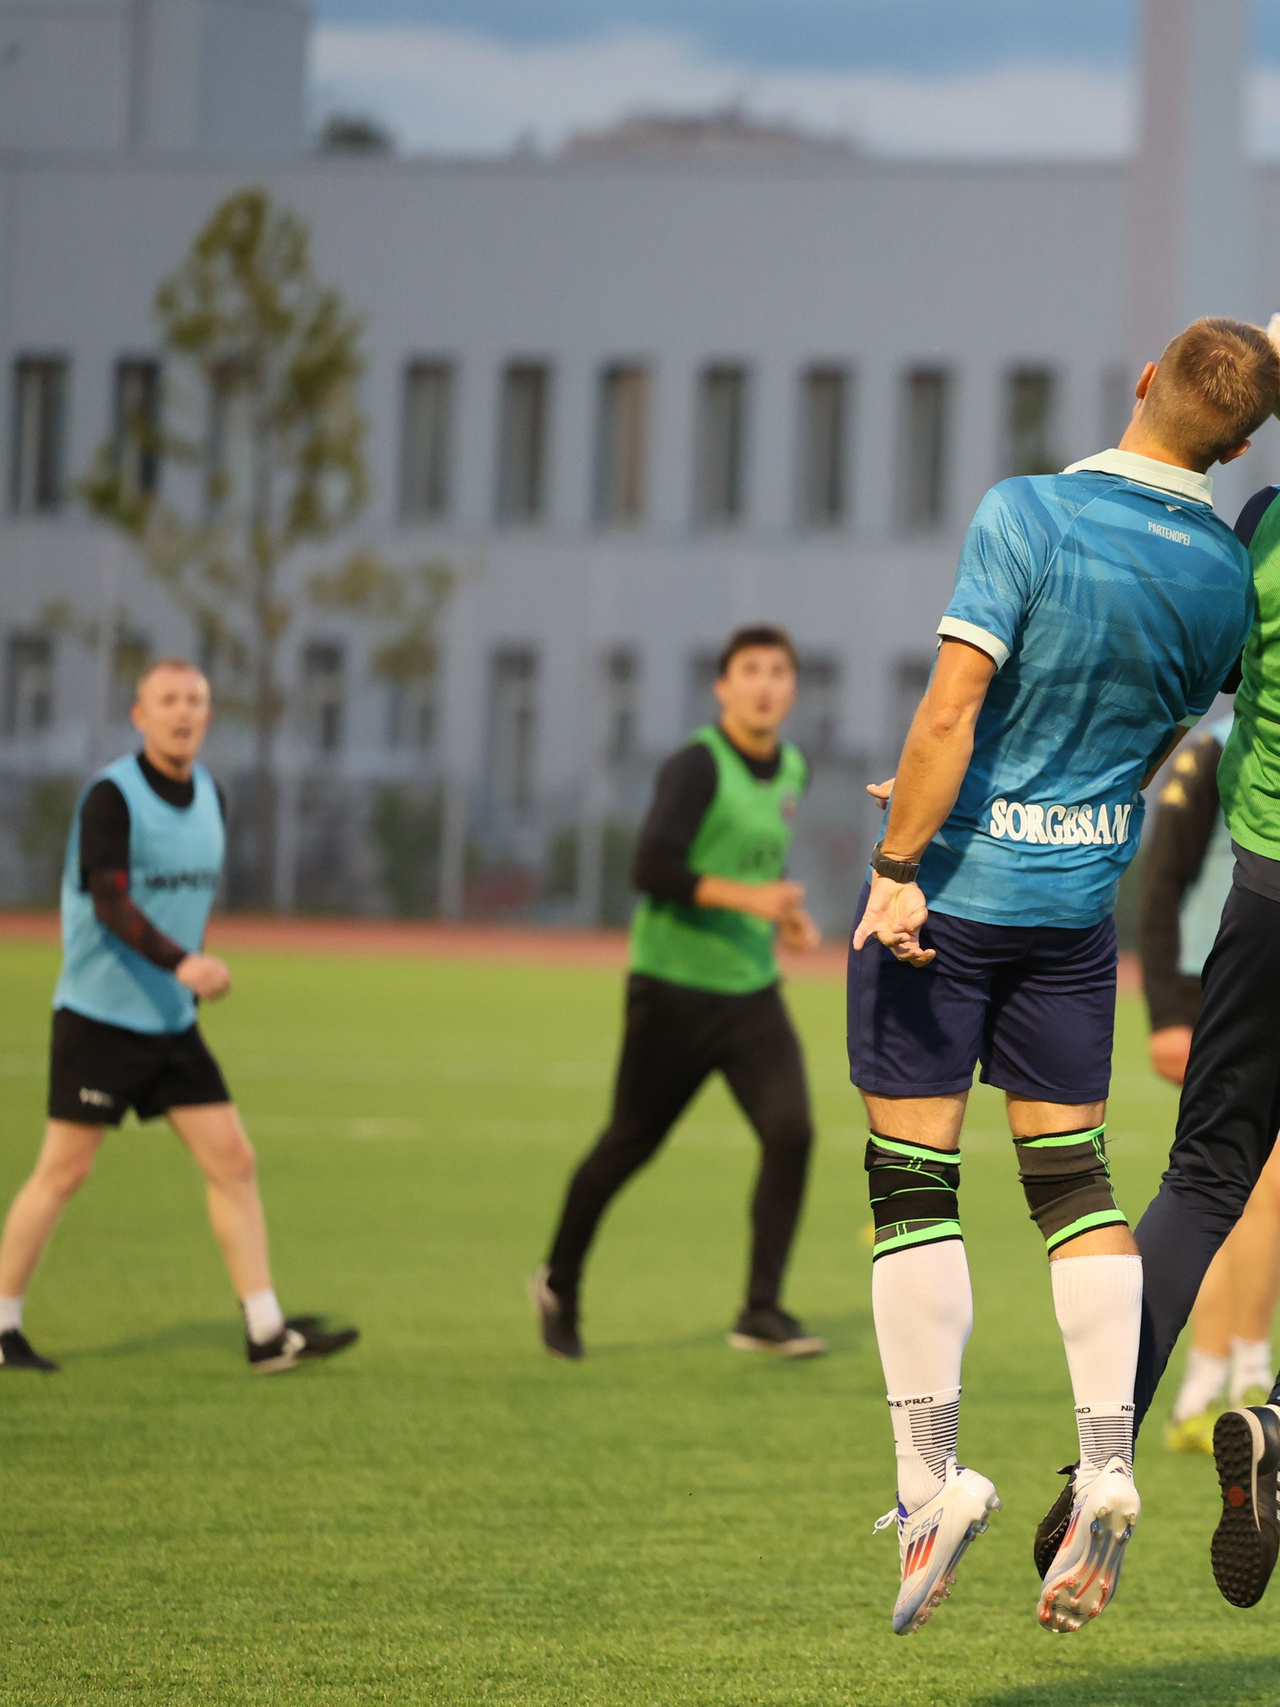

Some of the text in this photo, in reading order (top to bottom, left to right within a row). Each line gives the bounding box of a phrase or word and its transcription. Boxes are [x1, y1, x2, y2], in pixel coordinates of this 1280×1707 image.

[1147, 520, 1191, 546] PARTENOPEI
[989, 798, 1134, 845] SORGESAN
[904, 1396, 934, 1406] PRO
[909, 1507, 944, 1542] F50
